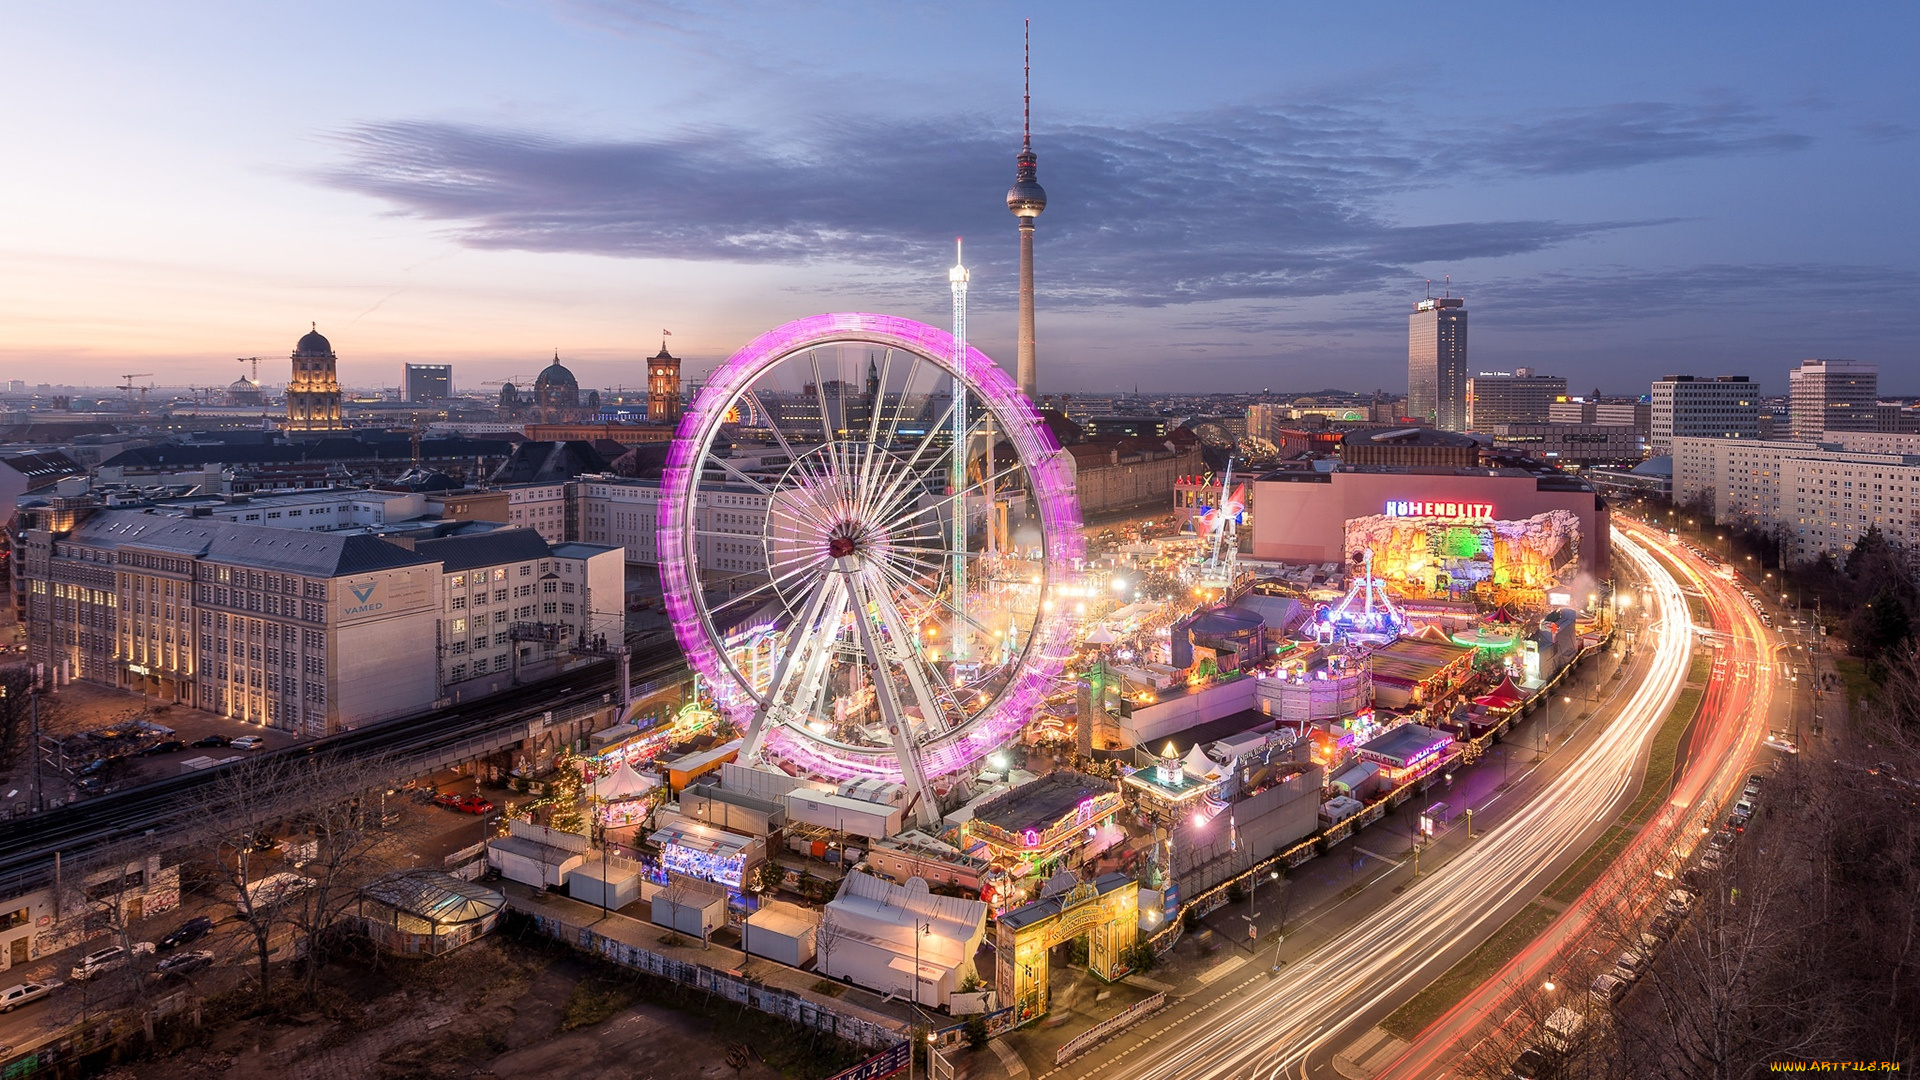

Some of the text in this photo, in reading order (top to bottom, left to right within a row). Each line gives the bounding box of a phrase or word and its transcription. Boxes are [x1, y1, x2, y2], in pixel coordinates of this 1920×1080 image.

[1176, 471, 1222, 491] ALEXA
[1386, 501, 1493, 520] HÖHENBLITZ
[344, 602, 383, 615] VAMED
